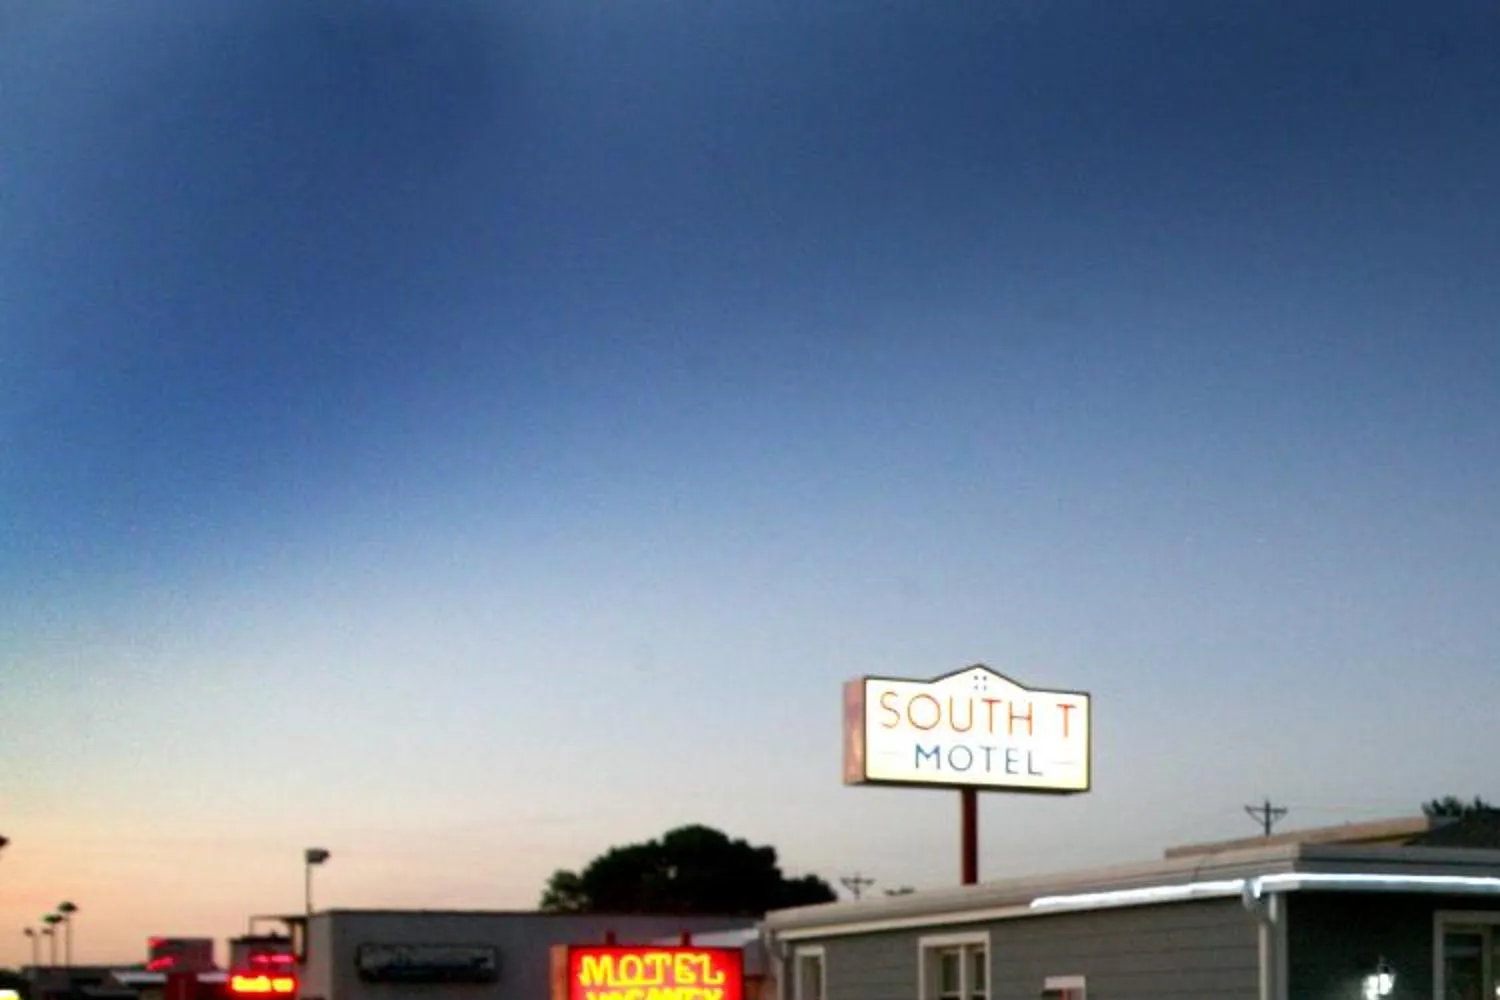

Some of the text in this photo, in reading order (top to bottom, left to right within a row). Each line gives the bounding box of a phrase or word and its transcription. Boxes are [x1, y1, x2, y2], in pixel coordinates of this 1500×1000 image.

[878, 691, 1076, 737] SOUTH T
[914, 743, 1042, 776] MOTEL
[579, 952, 725, 987] MOTEL
